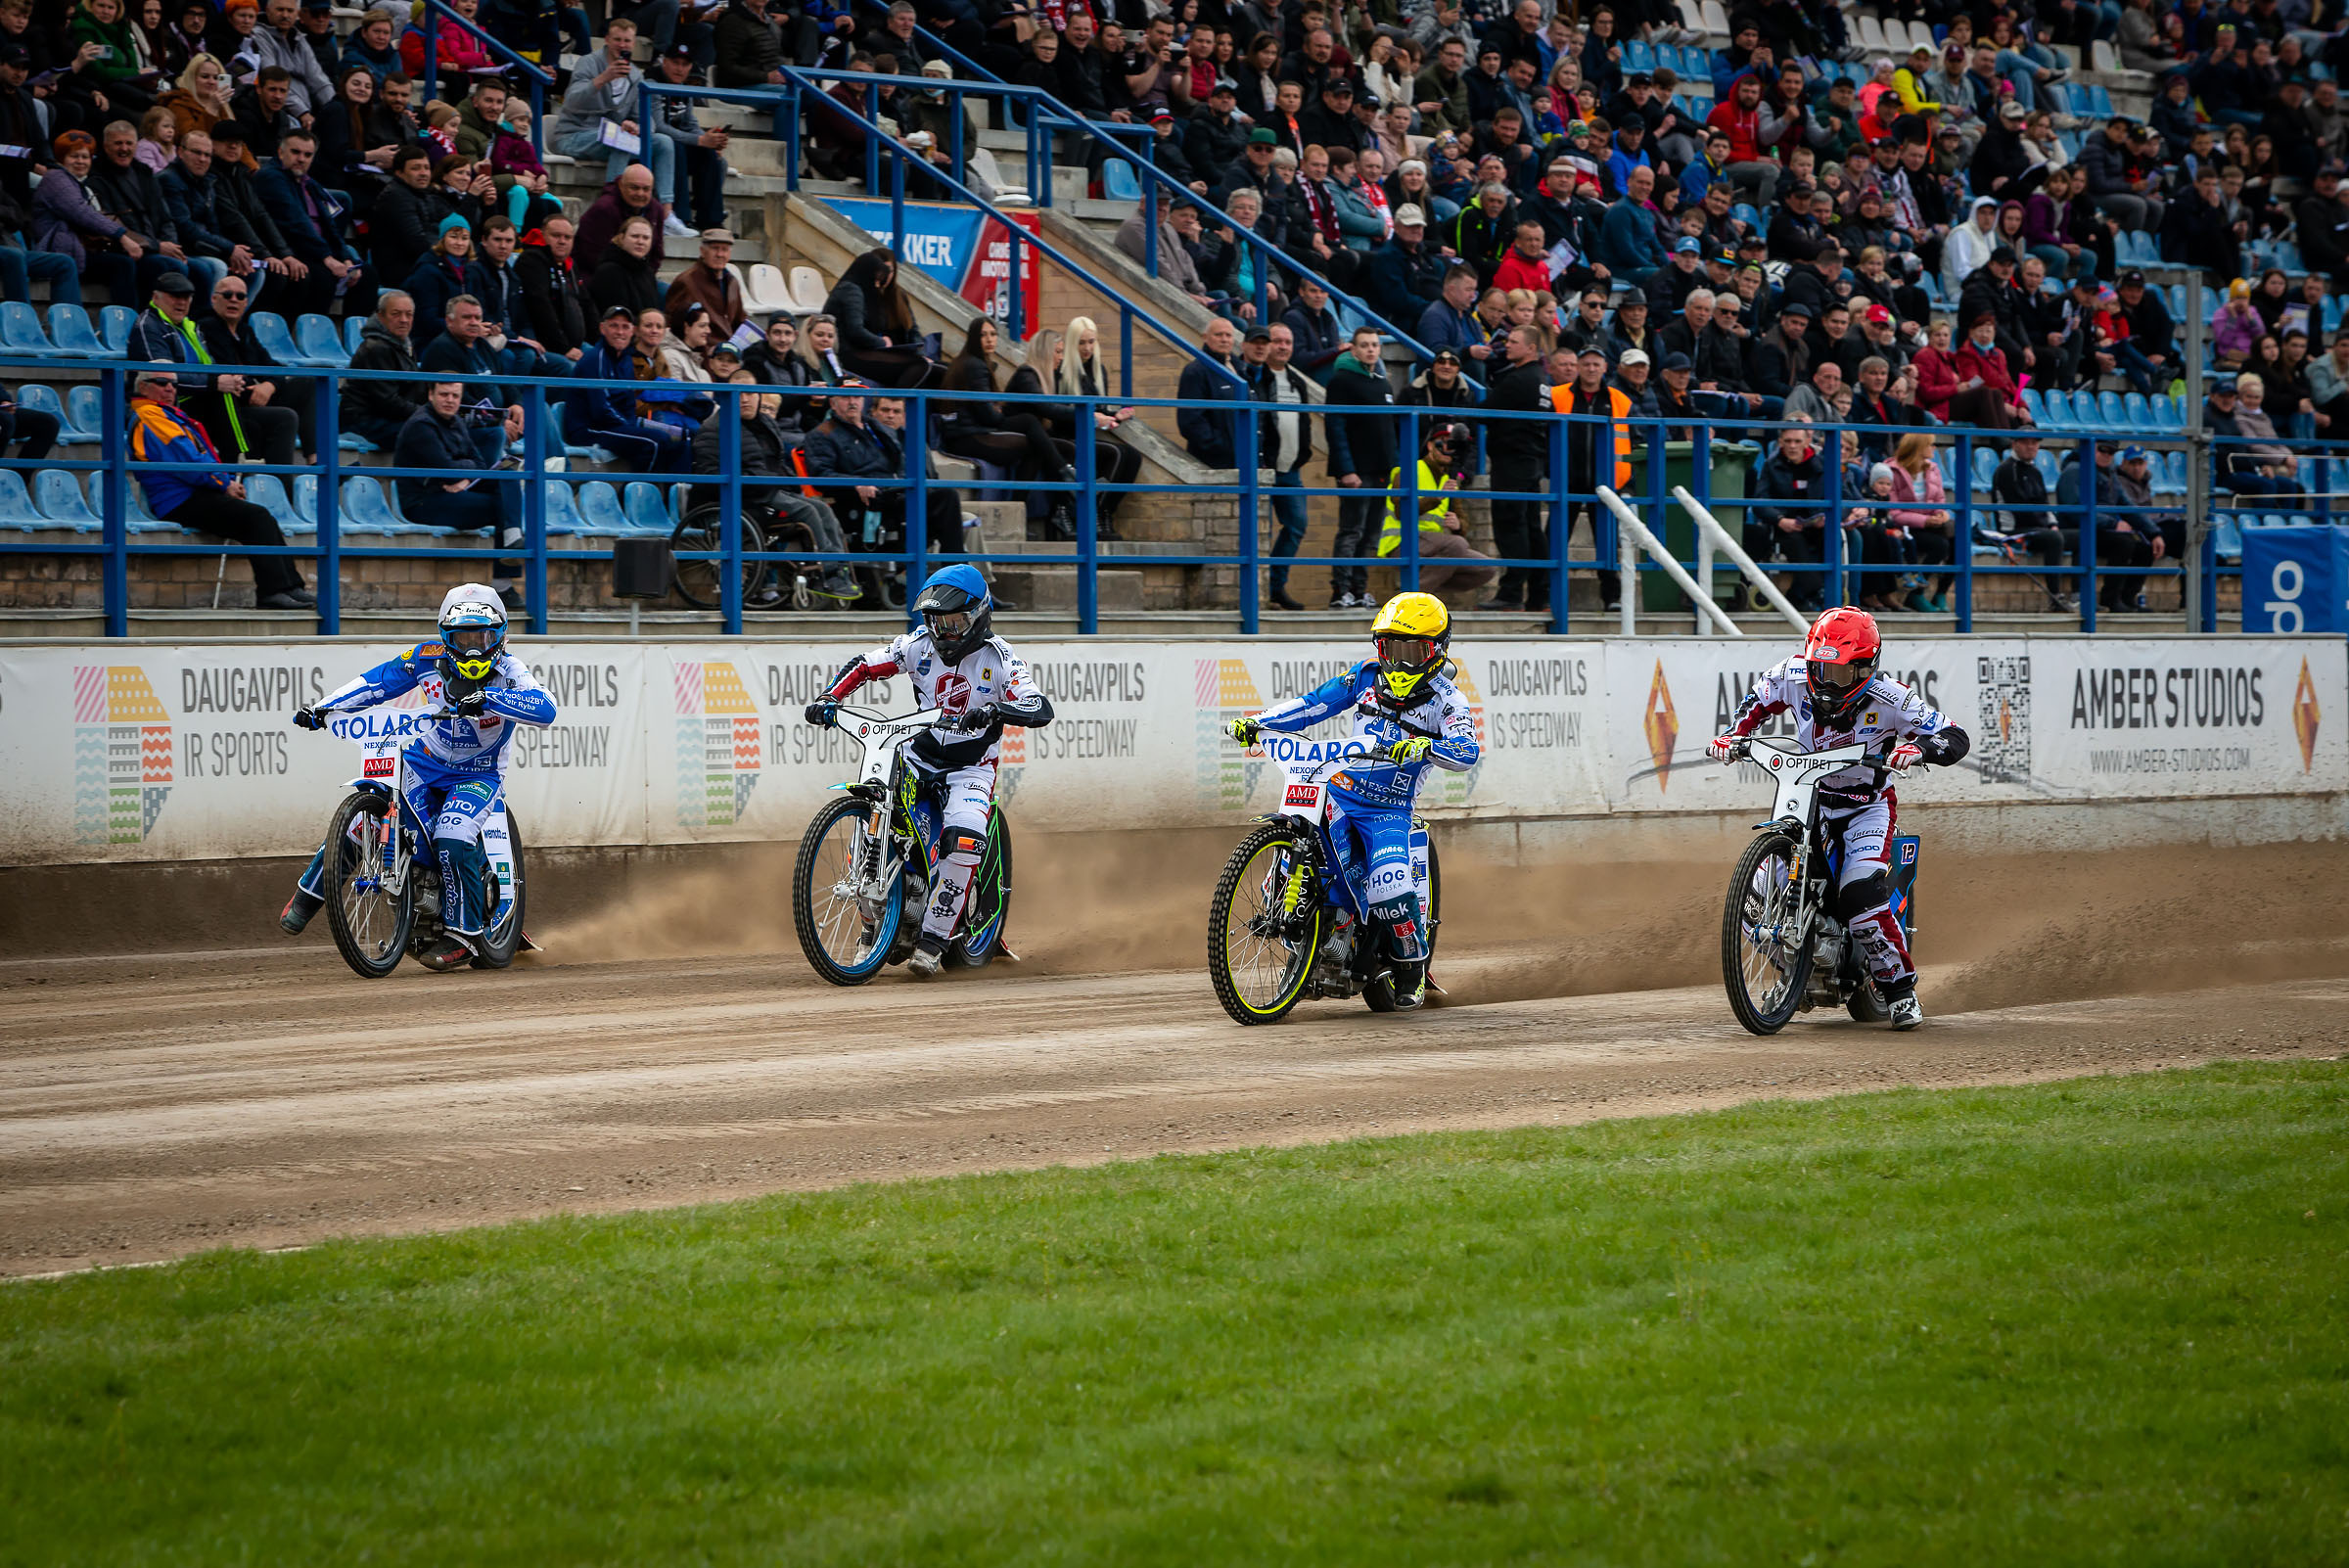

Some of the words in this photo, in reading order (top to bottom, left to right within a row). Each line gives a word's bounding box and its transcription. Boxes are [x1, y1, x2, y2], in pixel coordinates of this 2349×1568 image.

[181, 667, 324, 713] DAUGAVPILS
[1033, 663, 1144, 702] DAUGAVPILS
[1489, 660, 1588, 696] DAUGAVPILS
[2071, 669, 2158, 728] AMBER
[2165, 668, 2265, 727] STUDIOS
[516, 726, 611, 768] SPEEDWAY
[770, 724, 787, 764] IR
[872, 724, 912, 735] OPTIBET
[1034, 725, 1049, 759] IS
[1055, 719, 1137, 759] SPEEDWAY
[1491, 713, 1506, 748] IS
[1510, 713, 1582, 748] SPEEDWAY
[184, 733, 204, 776] IR
[211, 731, 288, 776] SPORTS
[365, 760, 394, 770] AMD
[1289, 766, 1324, 775] NEXORIS
[1786, 758, 1831, 771] OPTIBET
[2091, 748, 2251, 773] WWW.AMBER-STUDIOS.COM
[1287, 787, 1318, 799] AMD
[1901, 843, 1915, 865] 12
[438, 850, 458, 921] wemoto.cz
[1372, 869, 1405, 889] HOG
[1376, 883, 1403, 895] POLSKA
